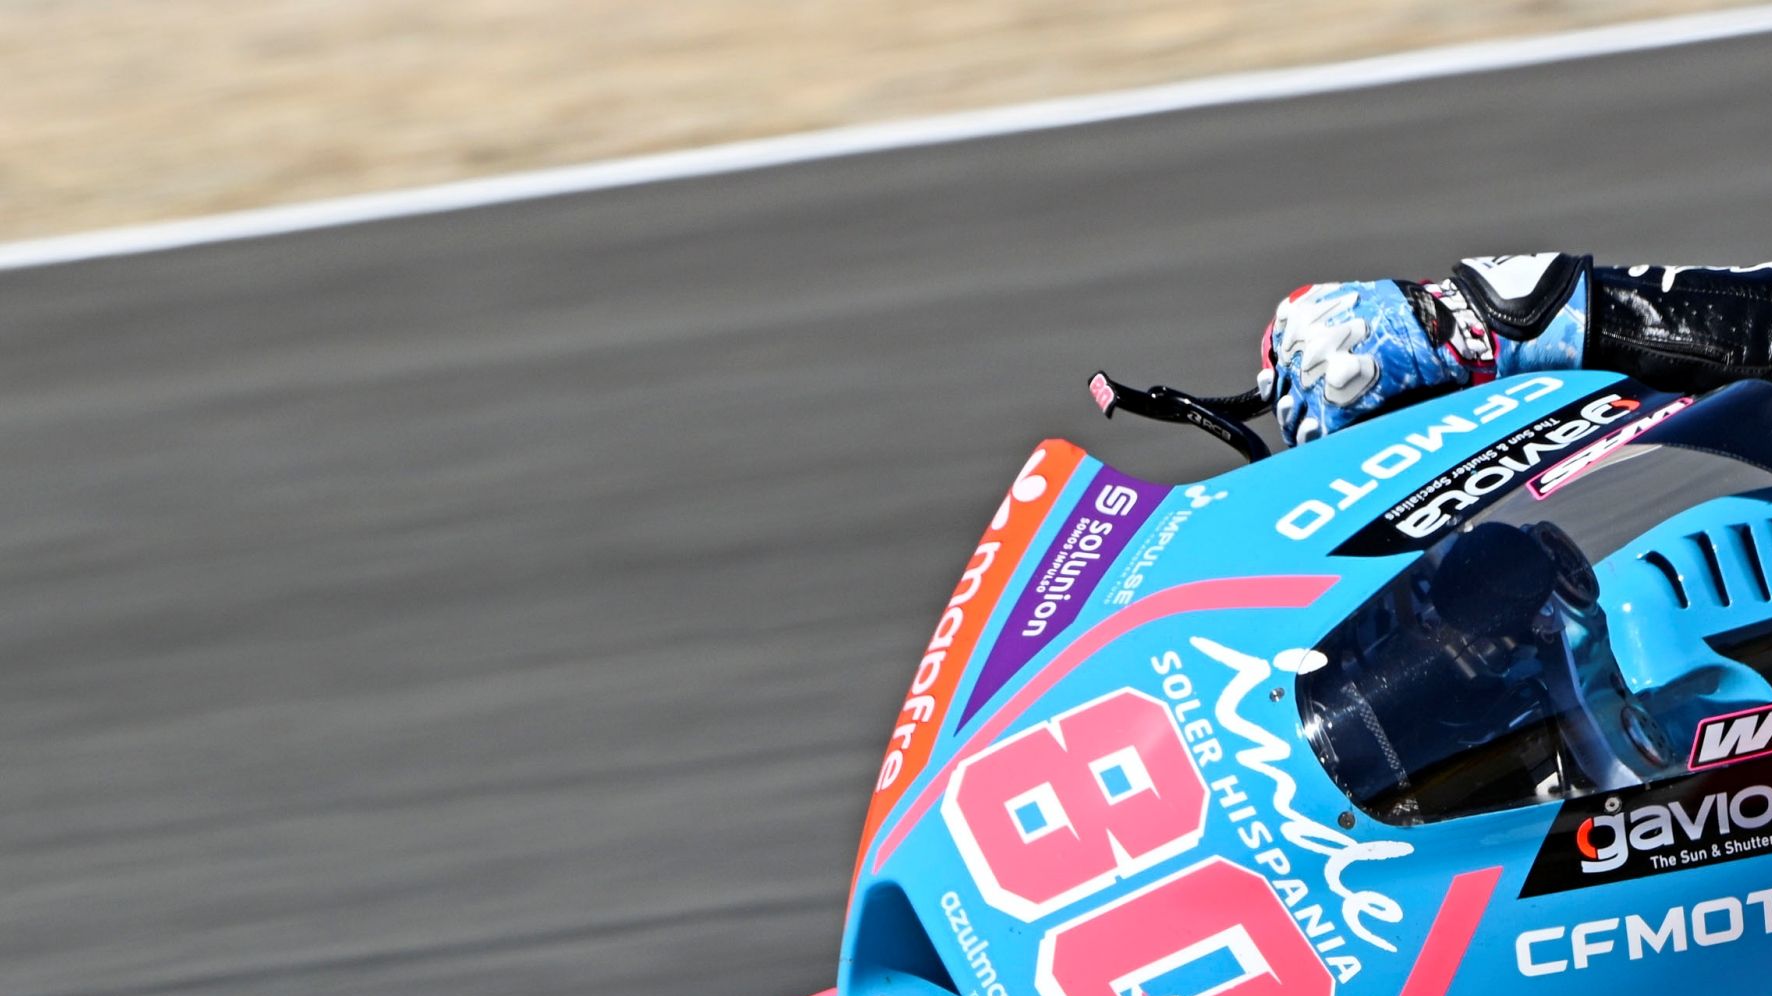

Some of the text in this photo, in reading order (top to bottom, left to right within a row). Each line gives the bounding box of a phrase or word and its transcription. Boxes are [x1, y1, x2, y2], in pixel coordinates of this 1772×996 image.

[1275, 377, 1565, 540] CFMOTO
[1384, 418, 1560, 521] The Sun & Shutter Specialists
[1396, 394, 1640, 539] gaviota
[1022, 520, 1112, 636] solunion
[1036, 517, 1090, 593] SOMOS IMPULSO
[1113, 511, 1192, 606] IMPULSE
[875, 542, 1001, 793] mapfre
[1151, 650, 1362, 985] SOLER HISPANIA
[1649, 851, 1677, 871] The
[1680, 846, 1708, 865] Sun
[1711, 843, 1722, 858] &
